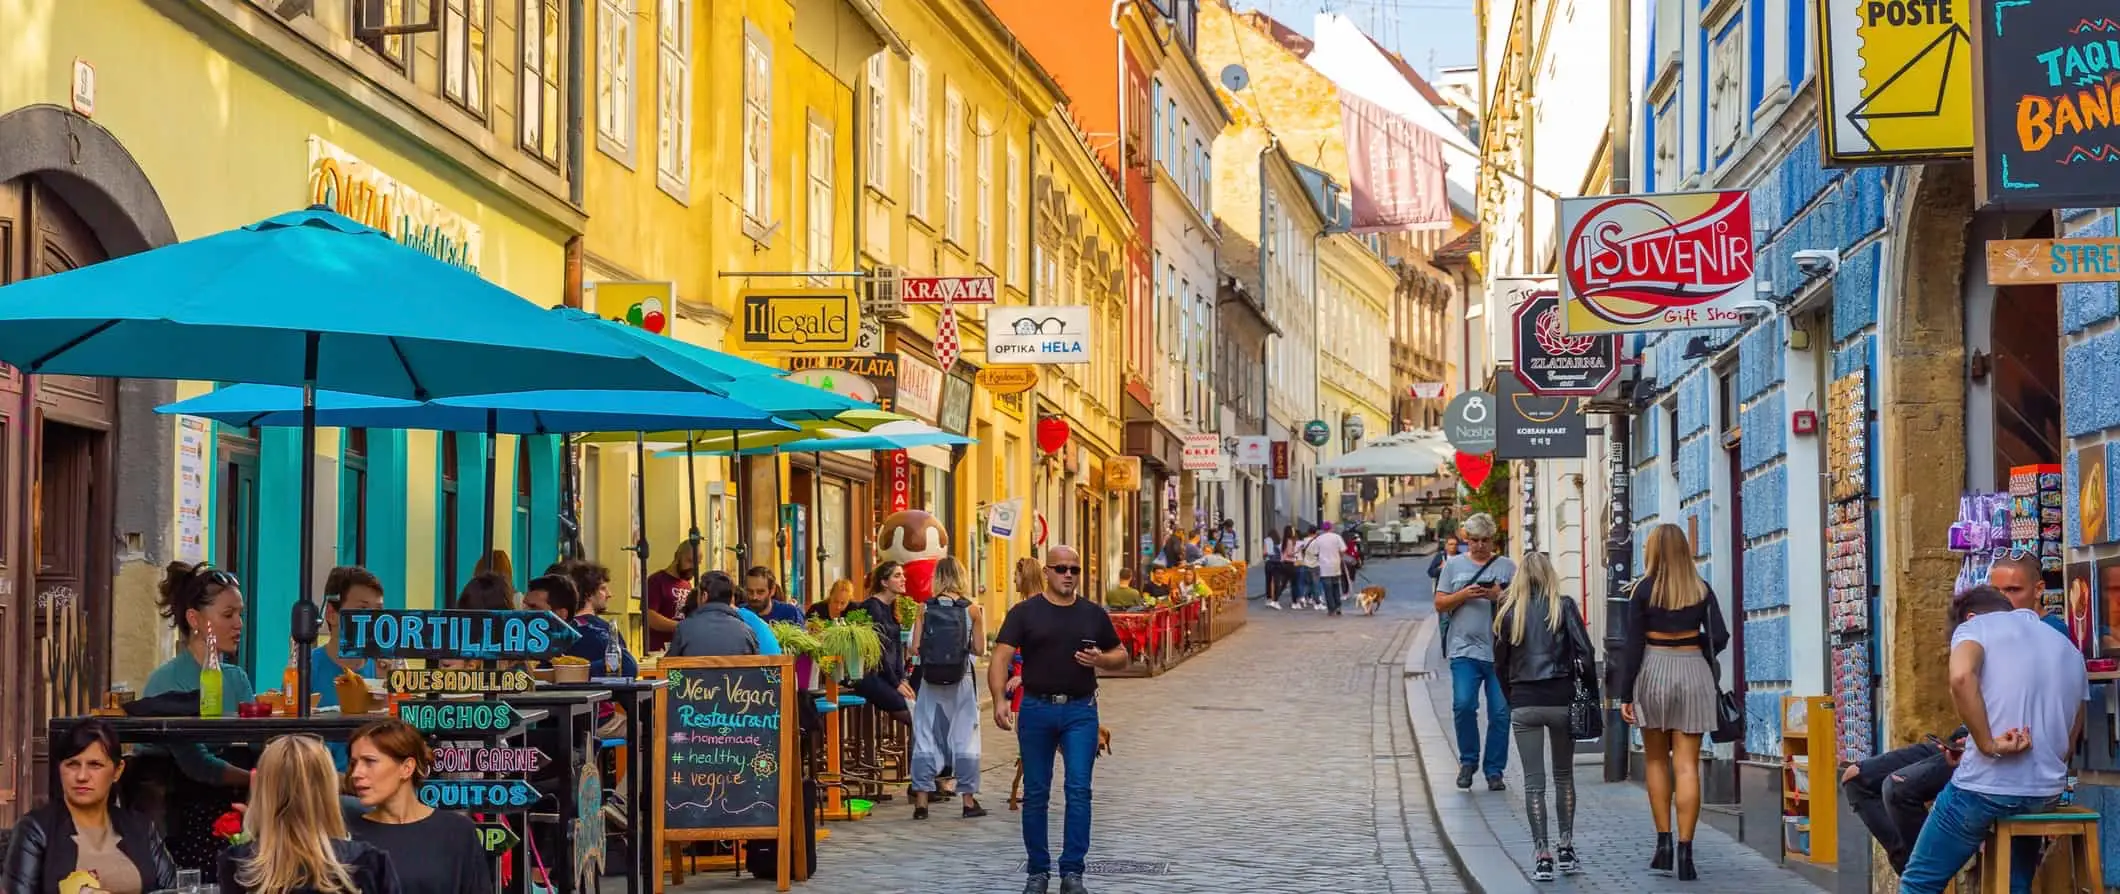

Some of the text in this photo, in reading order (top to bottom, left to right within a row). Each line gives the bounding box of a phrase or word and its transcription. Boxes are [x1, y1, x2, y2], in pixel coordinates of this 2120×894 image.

[1868, 0, 1953, 27] POSTE
[2050, 244, 2120, 274] STRE
[903, 278, 993, 299] KRAVATA
[747, 303, 845, 345] Illegale
[1664, 309, 1697, 326] Gift
[995, 341, 1082, 354] OPTIKA HELA
[848, 357, 896, 376] ZLATA
[1530, 357, 1606, 370] ZLATARNA
[1516, 427, 1567, 435] KOREAN MART
[895, 452, 905, 512] CROA
[351, 614, 551, 653] TORTILLAS
[390, 671, 529, 694] QUESADILLAS
[676, 673, 777, 714] New Vegan
[400, 704, 511, 730] NACHOS
[677, 703, 781, 730] Restaurant
[432, 747, 472, 773] CON
[475, 747, 540, 773] CARNE
[688, 747, 747, 775] healthy
[415, 783, 529, 809] QUITOS
[690, 770, 745, 801] veggie
